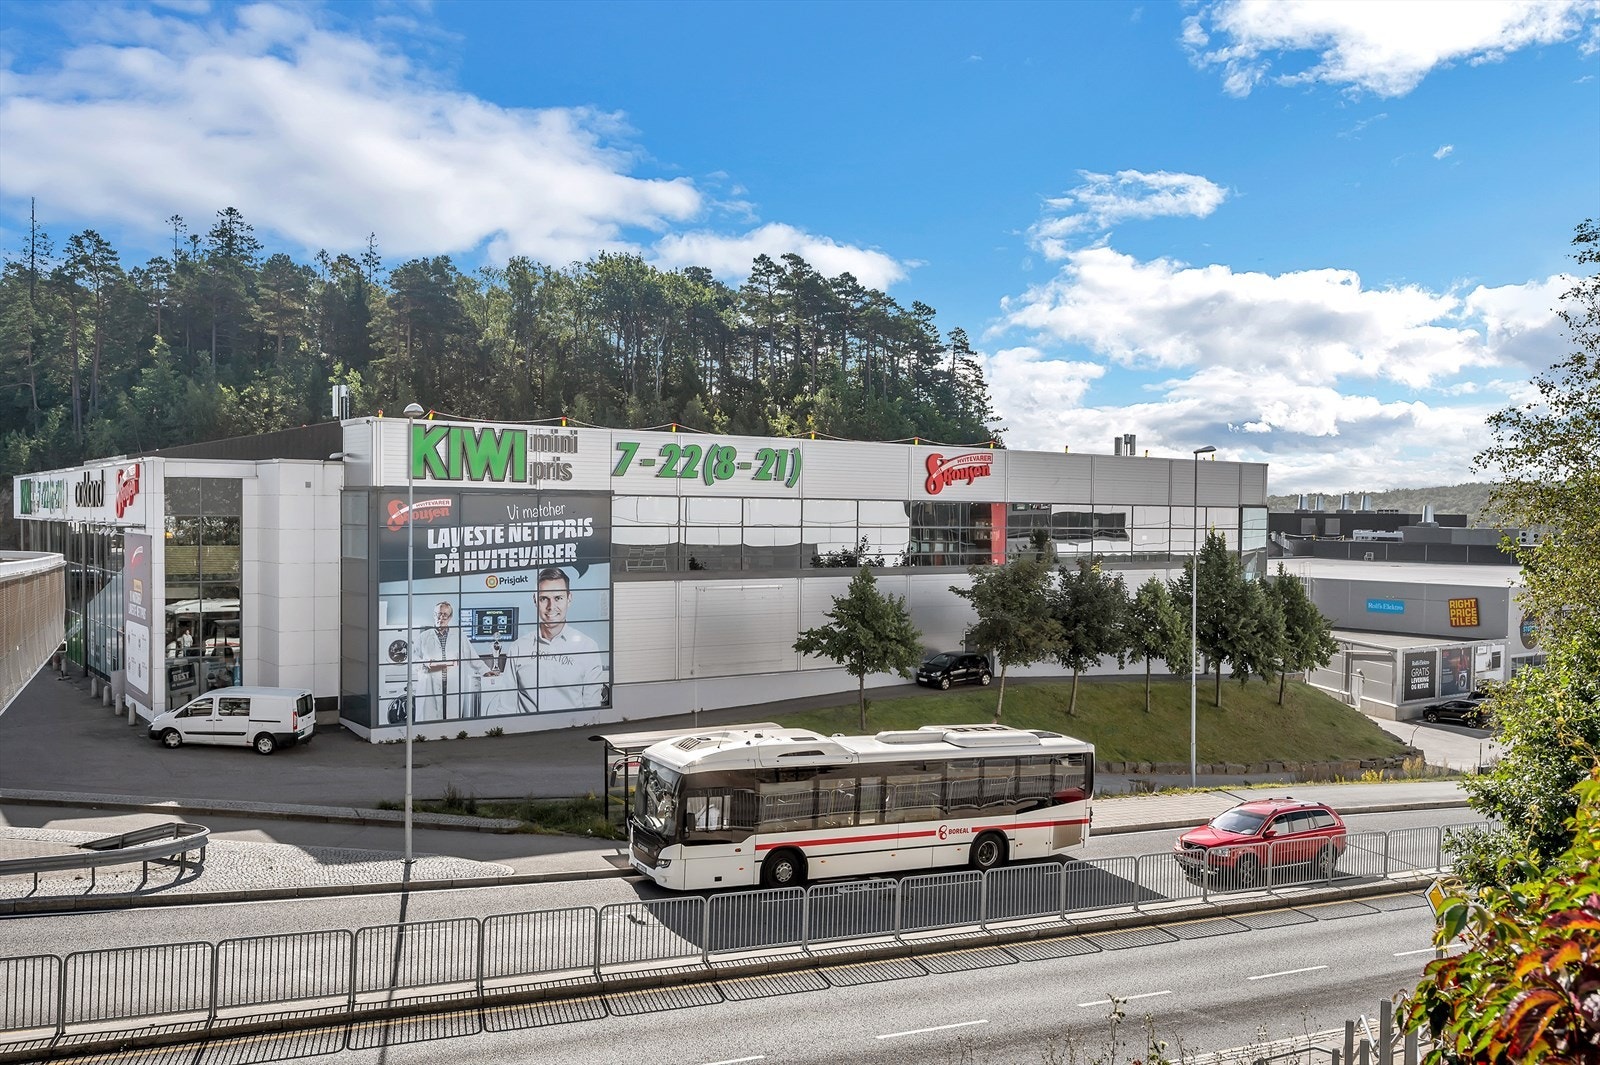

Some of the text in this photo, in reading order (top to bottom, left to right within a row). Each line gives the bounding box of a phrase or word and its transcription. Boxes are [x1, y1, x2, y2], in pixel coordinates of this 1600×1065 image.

[530, 430, 578, 454] mini
[410, 424, 528, 483] KIWI
[957, 455, 992, 464] HVITEVARER
[530, 457, 573, 485] pris
[925, 453, 991, 495] Skousen
[507, 502, 567, 520] Vi matcher
[427, 517, 594, 549] LAVESTE NETTPRIS
[434, 542, 578, 575] PÅ HVITEVARER
[499, 575, 529, 587] Prisjakt
[1449, 599, 1476, 609] RIGHT
[1450, 608, 1477, 617] PRICE
[1451, 616, 1478, 626] TILES
[172, 671, 190, 682] BEST
[1411, 667, 1430, 677] GRATIS
[949, 827, 969, 835] BOREAL
